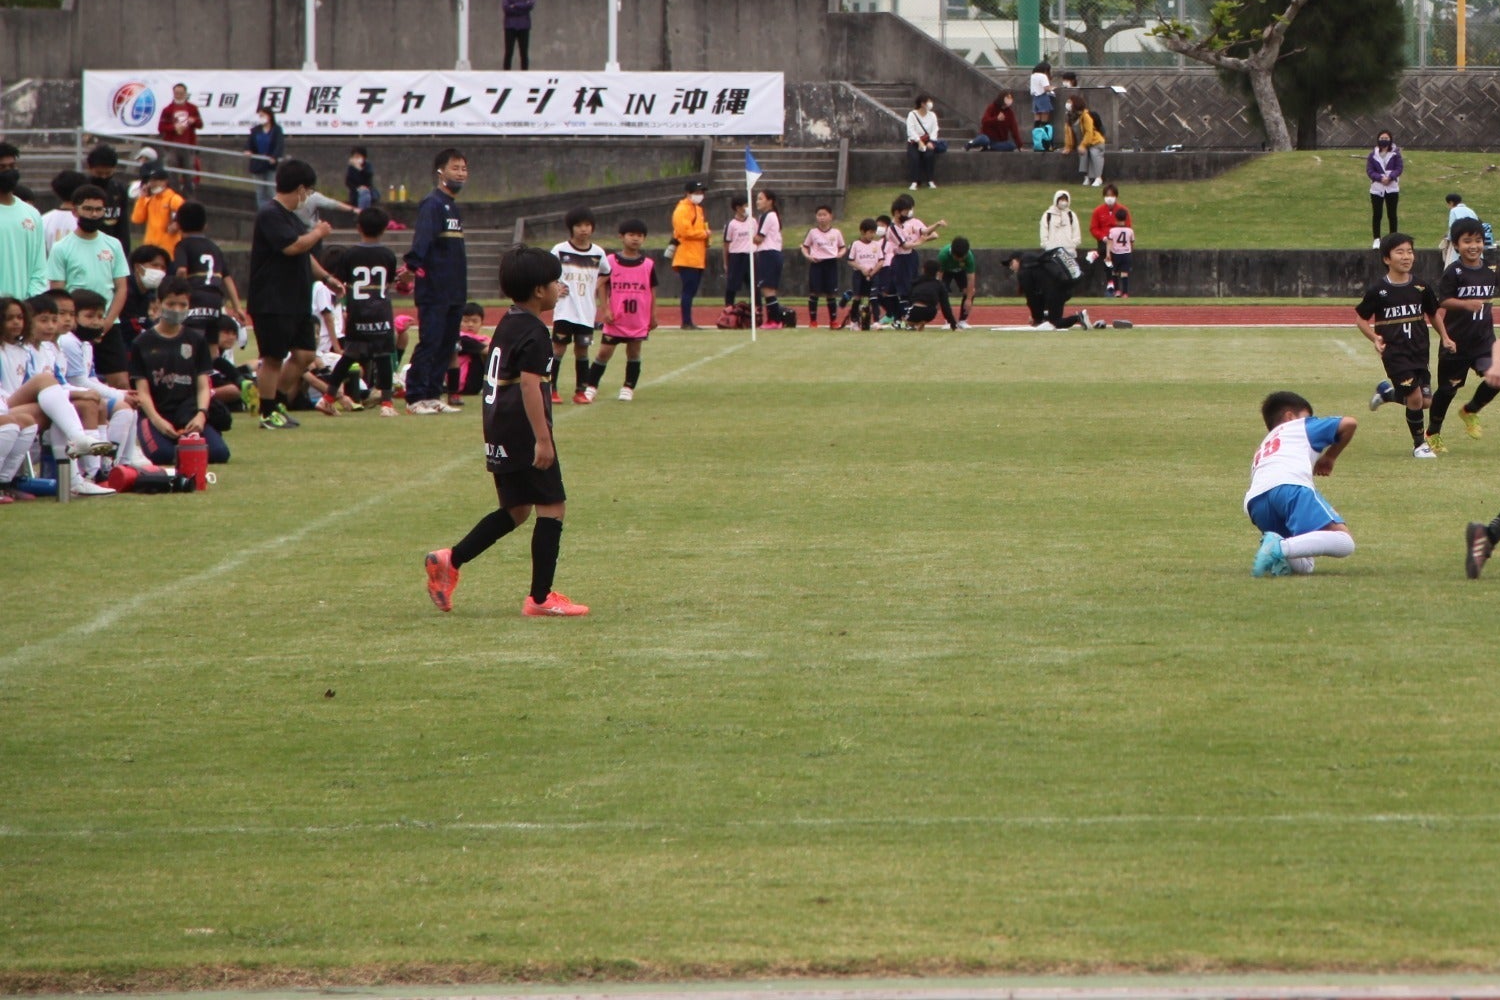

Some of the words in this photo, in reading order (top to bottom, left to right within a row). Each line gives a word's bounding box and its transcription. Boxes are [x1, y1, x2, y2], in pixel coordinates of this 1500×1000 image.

[257, 78, 608, 115] 国際チャレンジ杯
[623, 93, 657, 116] IN
[669, 87, 751, 116] 沖縄
[1116, 231, 1128, 247] 4
[199, 253, 215, 286] 7
[352, 265, 388, 301] 27
[622, 298, 638, 315] 10
[354, 320, 392, 333] ZELVA
[1402, 322, 1412, 340] 4
[484, 346, 502, 405] 9
